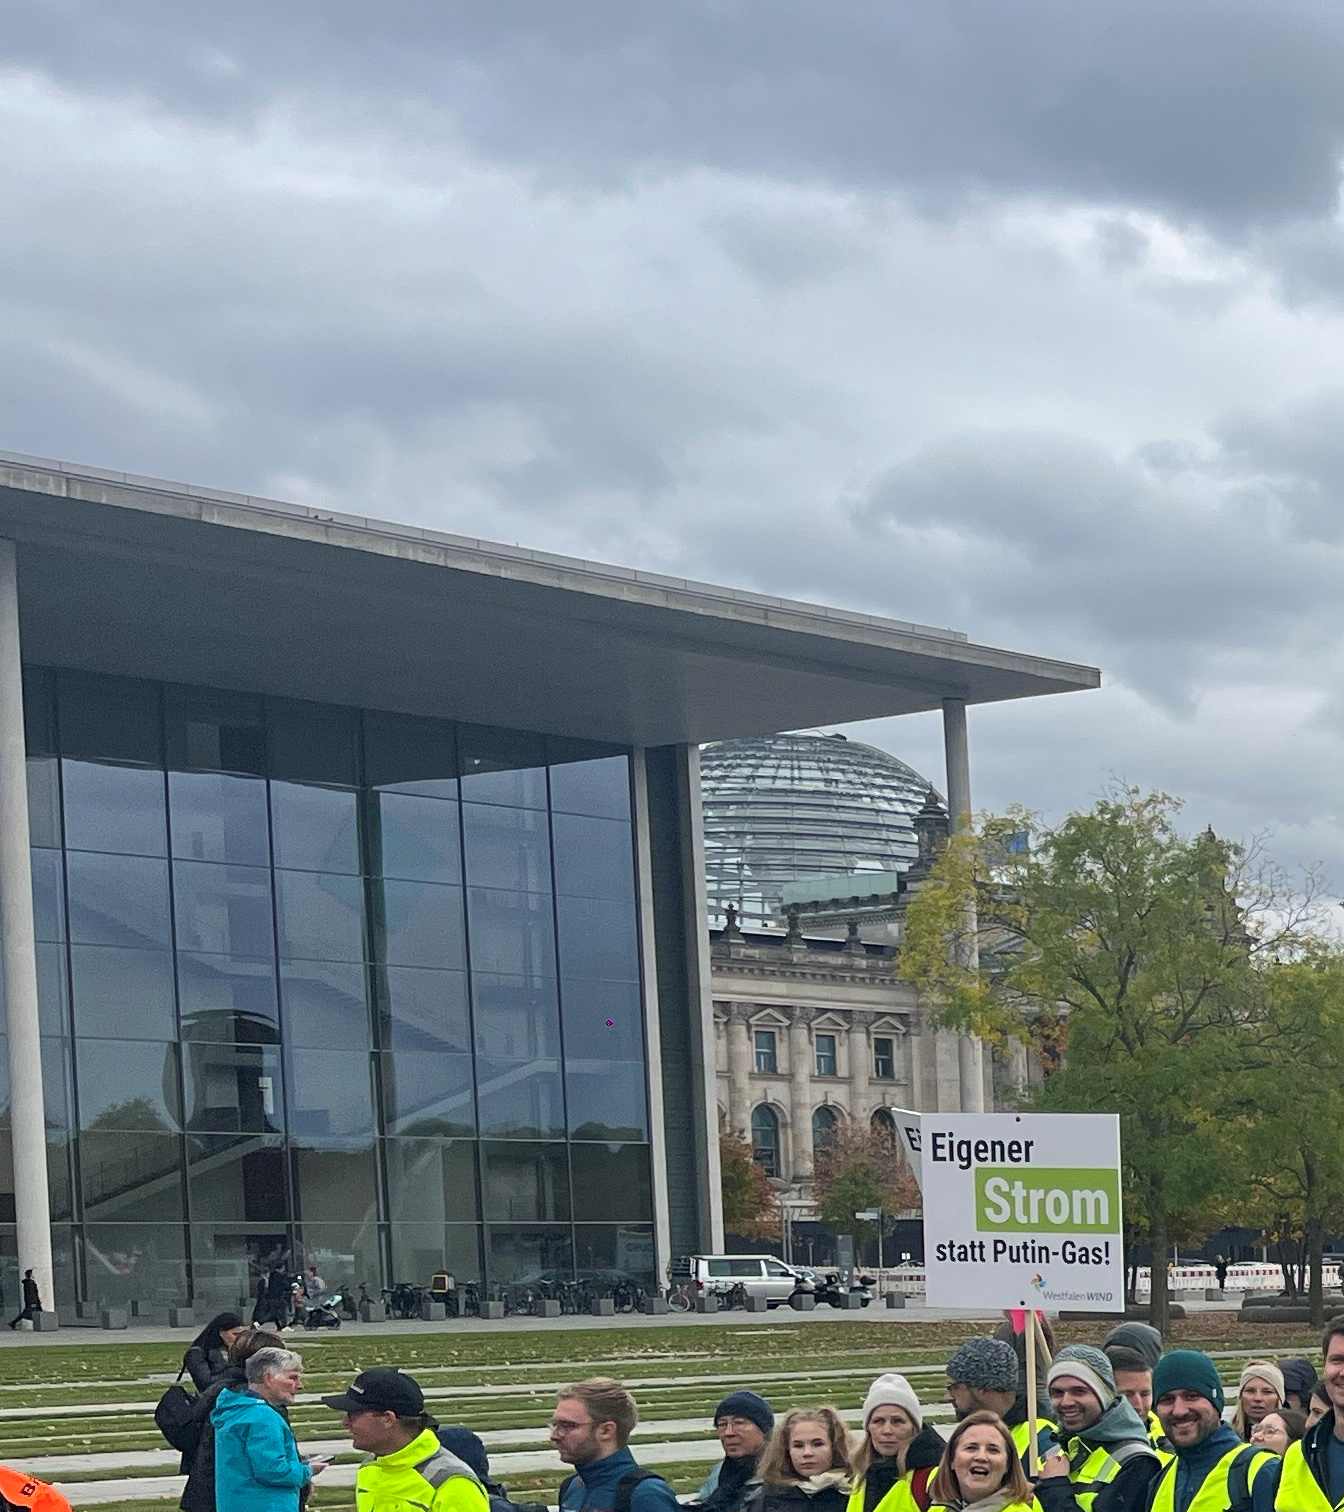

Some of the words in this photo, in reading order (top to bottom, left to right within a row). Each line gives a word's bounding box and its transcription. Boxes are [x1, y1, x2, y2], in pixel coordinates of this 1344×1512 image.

[932, 1132, 1034, 1170] Eigener
[984, 1177, 1109, 1225] Strom
[936, 1240, 985, 1262] statt
[993, 1240, 1110, 1265] Putin-Gas!
